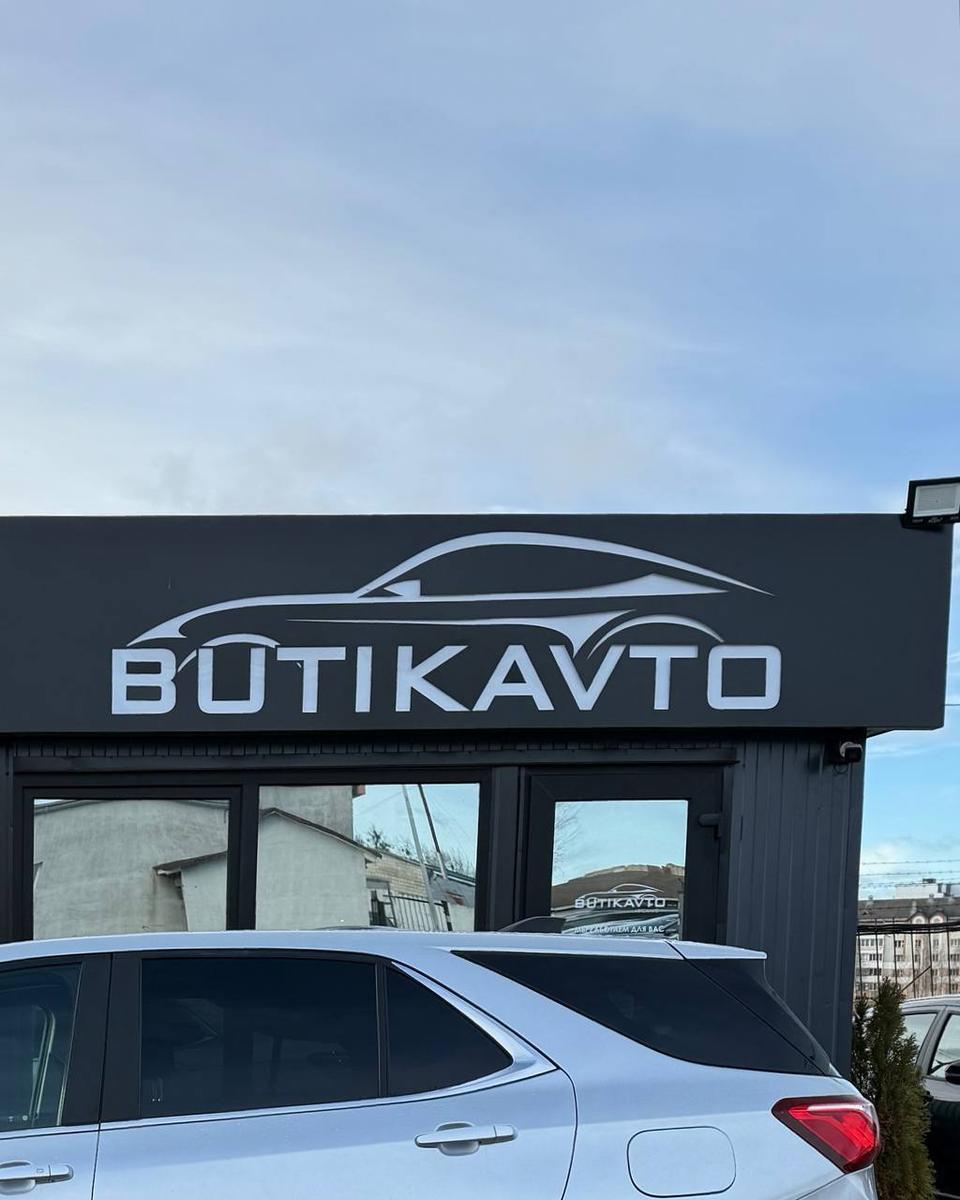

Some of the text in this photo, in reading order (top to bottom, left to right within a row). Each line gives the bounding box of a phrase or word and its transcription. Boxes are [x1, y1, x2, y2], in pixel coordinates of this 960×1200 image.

[111, 639, 782, 715] BUTIKAVTO
[574, 898, 666, 909] BUTIKAVTO
[648, 925, 665, 933] ВАС
